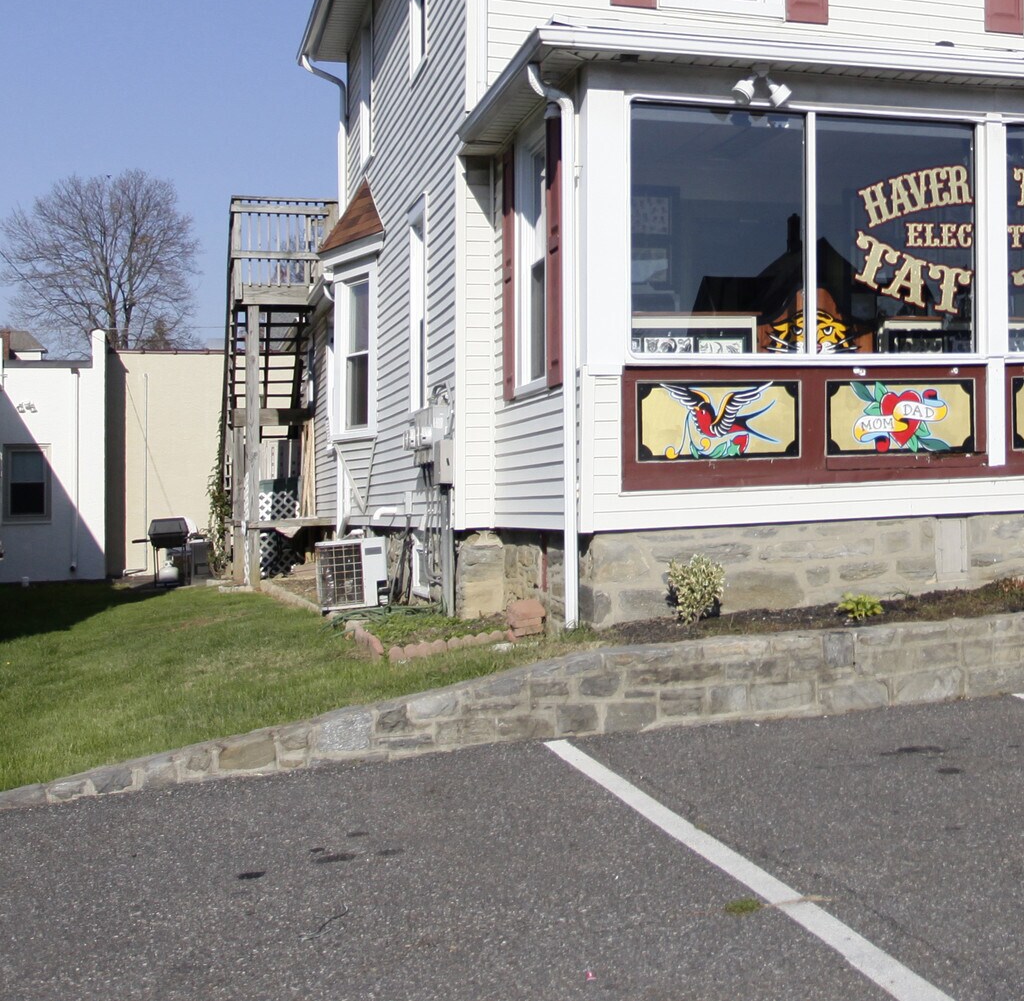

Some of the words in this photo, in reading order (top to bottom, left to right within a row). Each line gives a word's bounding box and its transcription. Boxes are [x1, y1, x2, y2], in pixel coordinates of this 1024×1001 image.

[857, 164, 973, 228] HAVER
[905, 222, 974, 248] ELEC
[854, 230, 973, 315] TAT
[903, 404, 935, 418] DAD
[861, 418, 894, 431] MOM
